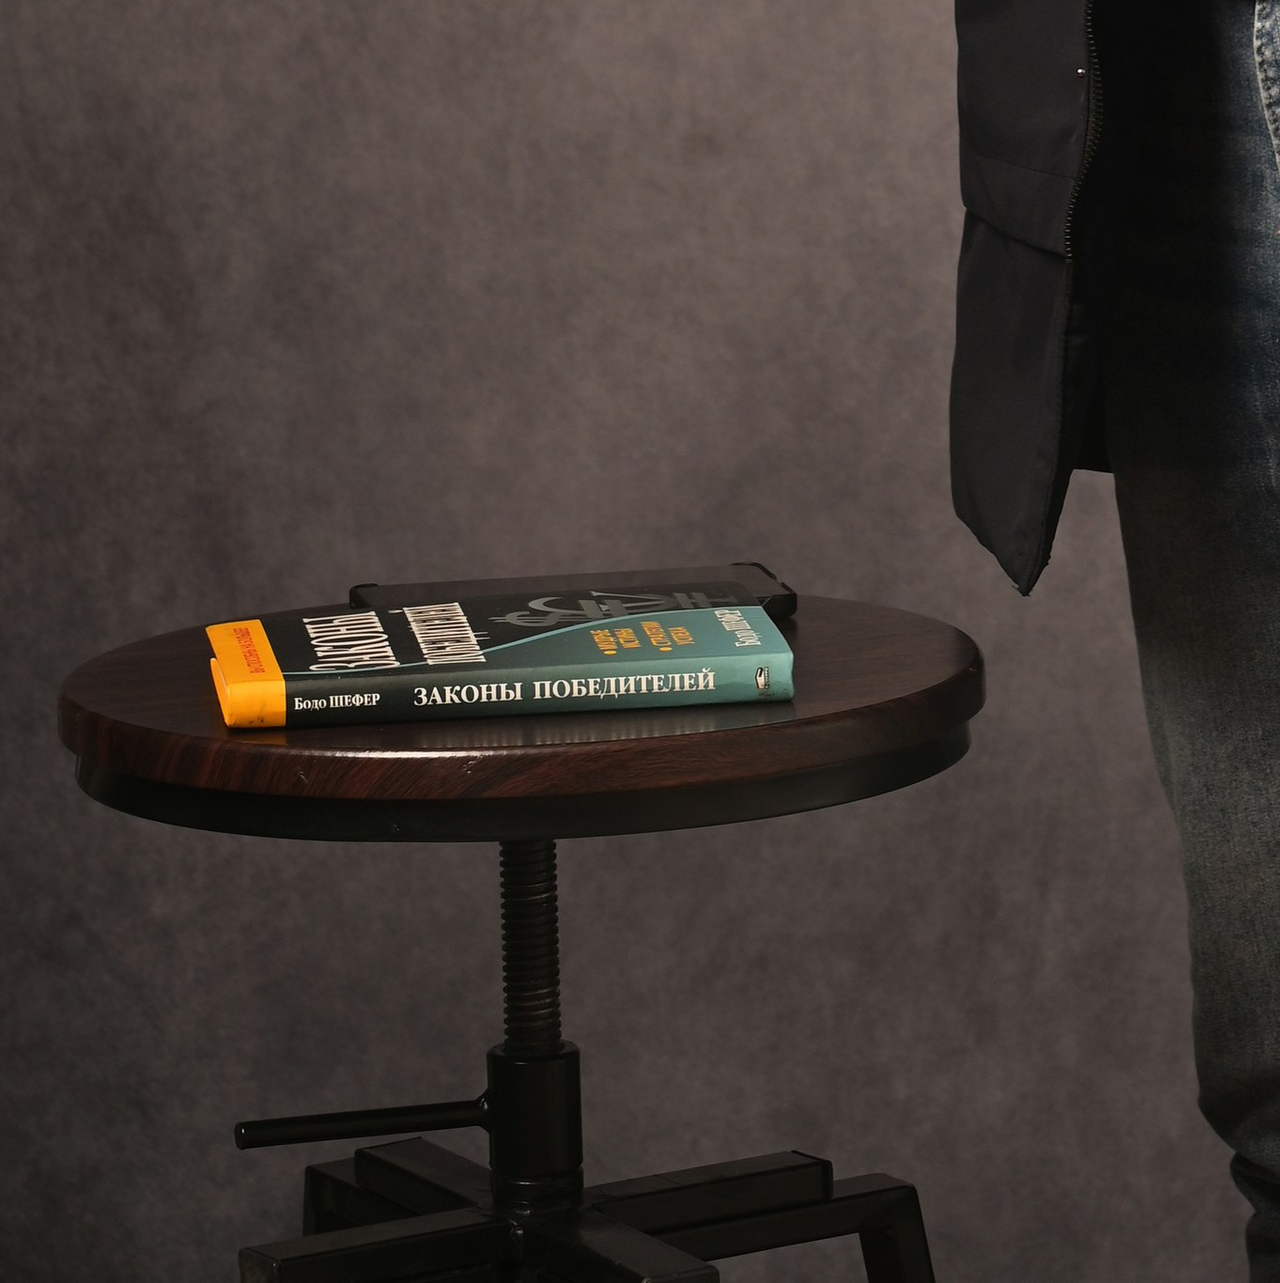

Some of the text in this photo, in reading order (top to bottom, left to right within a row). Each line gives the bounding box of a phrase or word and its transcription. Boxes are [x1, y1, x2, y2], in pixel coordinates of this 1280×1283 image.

[302, 611, 401, 671] ЗАКОНЫ
[388, 602, 491, 666] ПОБЕДИТЕЛЕЙ
[294, 693, 381, 711] Бодо ШЕФЕР
[413, 668, 716, 706] ЗАКОНЫ ПОБЕДИТЕЛЕЙ
